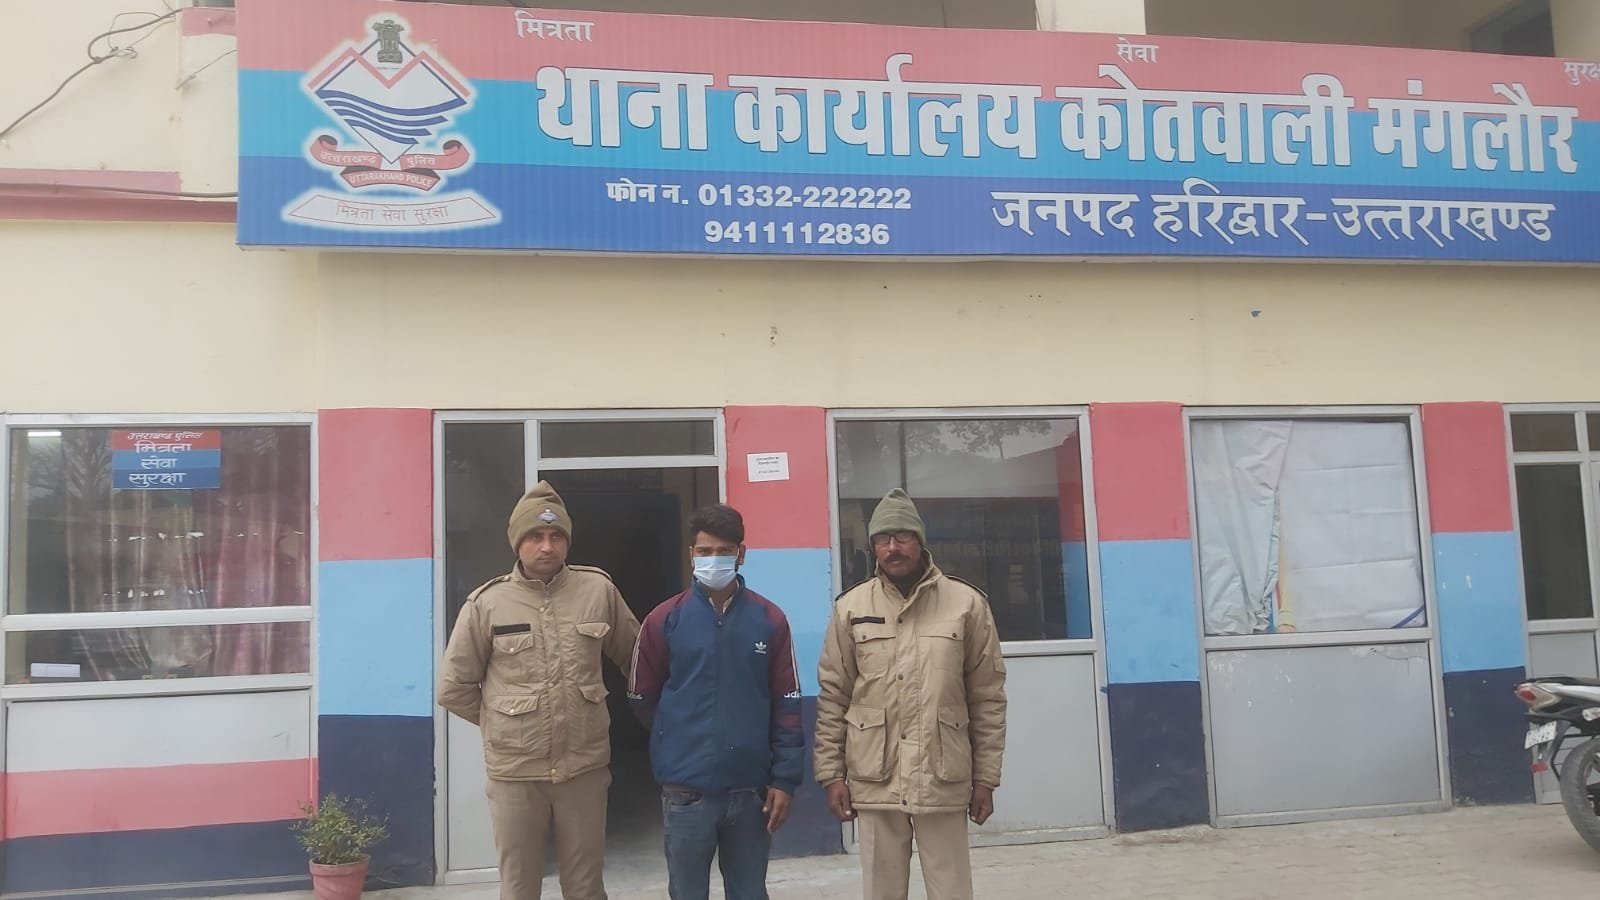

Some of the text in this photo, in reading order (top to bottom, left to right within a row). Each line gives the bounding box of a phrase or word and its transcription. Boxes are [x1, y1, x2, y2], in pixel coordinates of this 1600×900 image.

[514, 10, 594, 42] मित्रता
[1116, 37, 1159, 63] सेवा
[536, 53, 1579, 173] थाना कार्यालय कोतवाली मंगलौर
[349, 171, 433, 188] UTTARAKHAND POLICE
[605, 177, 657, 203] फोन
[698, 183, 912, 210] 01332-222222
[336, 200, 449, 225] मित्रता सेवा सुरक्षा
[990, 191, 1141, 238] जनपद
[704, 220, 890, 245] 9411112836
[133, 440, 192, 454] मित्रता
[141, 455, 178, 469] सेवा
[128, 472, 187, 488] सुरक्षा
